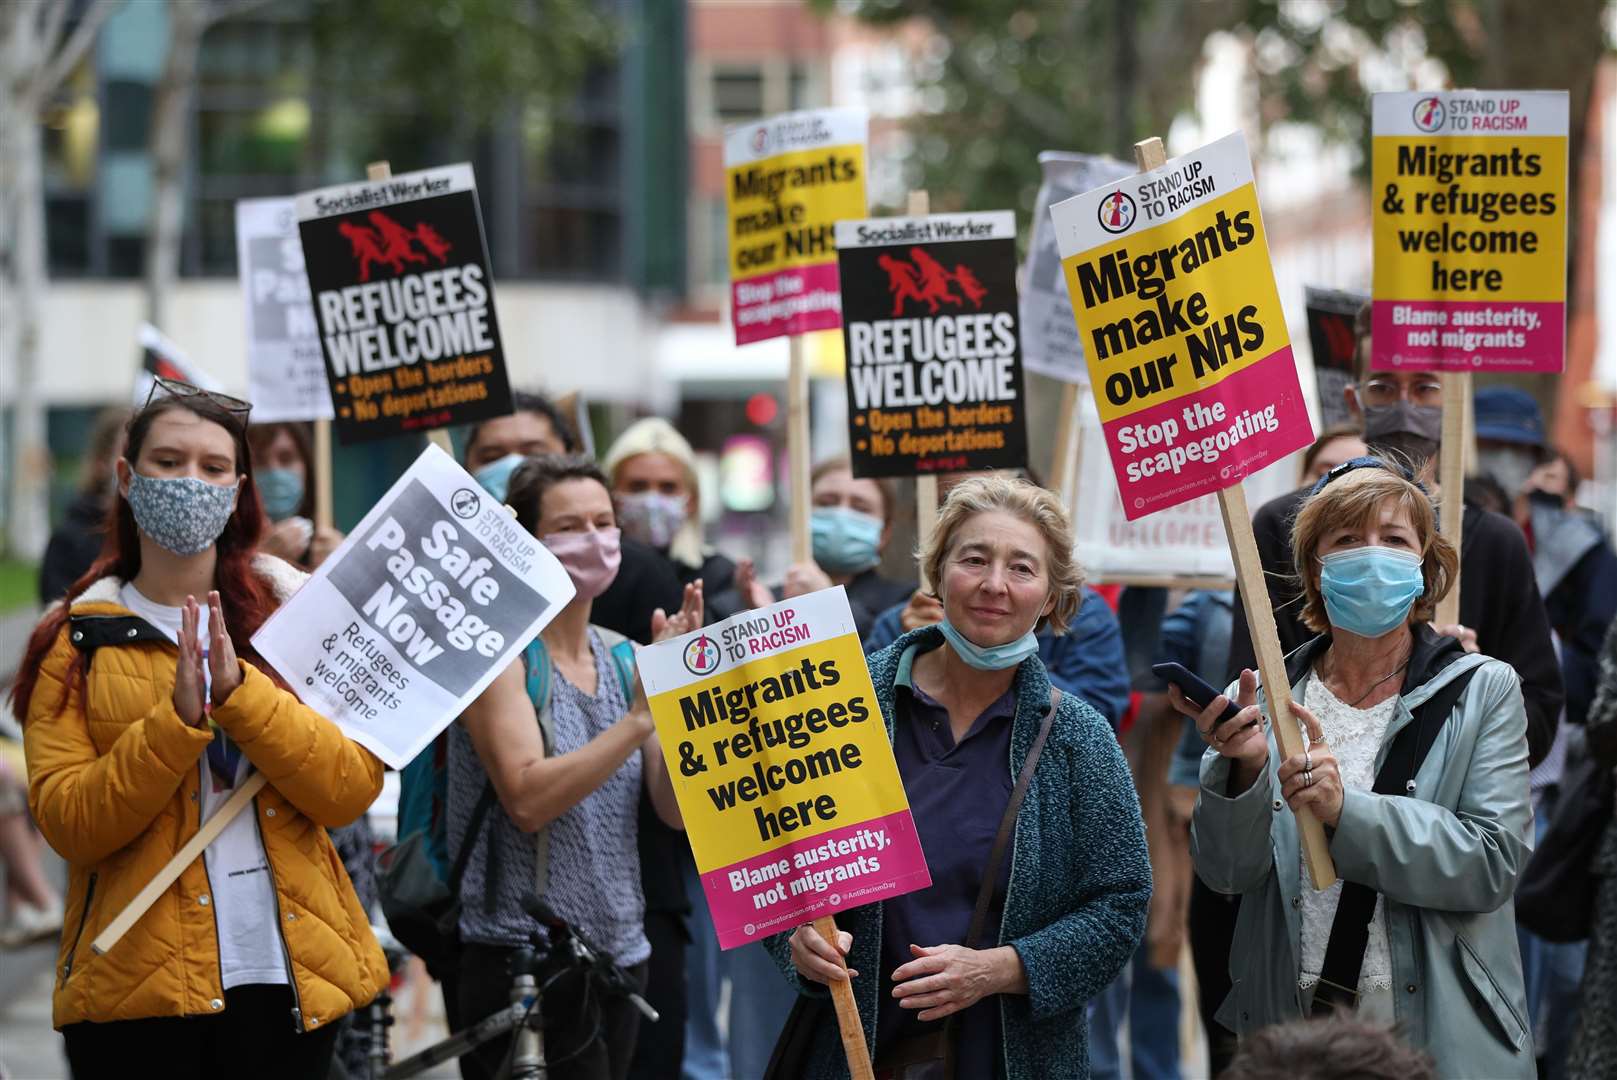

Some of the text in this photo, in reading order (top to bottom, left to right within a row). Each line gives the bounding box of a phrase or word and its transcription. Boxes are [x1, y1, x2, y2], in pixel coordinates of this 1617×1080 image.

[1450, 100, 1520, 114] STAND UP
[1450, 116, 1527, 130] TO RACISM
[734, 155, 856, 202] Migrants
[1138, 161, 1202, 202] STAND UP
[1397, 145, 1541, 184] Migrants
[315, 177, 451, 215] Socialist Worker
[735, 203, 806, 237] make
[1142, 175, 1216, 220] TO RACISM
[1382, 183, 1556, 222] & refugees
[736, 225, 835, 270] our NH
[857, 220, 993, 244] Socialist Worker
[1399, 223, 1538, 253] welcome
[1076, 209, 1255, 310] Migrants
[1432, 261, 1503, 291] here
[318, 263, 487, 335] REFUGEES
[736, 275, 804, 306] Stop the
[850, 312, 1015, 366] REFUGEES
[1091, 291, 1209, 360] make
[1393, 306, 1541, 330] Blame austerity,
[1407, 329, 1526, 351] not migrants
[325, 308, 494, 377] WELCOME
[1105, 305, 1265, 406] our NHS
[350, 355, 493, 400] Open the borders
[353, 399, 378, 422] No
[382, 381, 487, 417] deportations
[851, 357, 1016, 409] WELCOME
[868, 403, 1013, 434] Open the borders
[1117, 399, 1226, 454] Stop the
[870, 428, 1005, 458] No deportations
[1126, 404, 1280, 483] scapegoating
[475, 520, 532, 575] TO RACISM
[483, 509, 536, 567] STAND UP
[421, 520, 499, 605] Safe
[366, 516, 505, 658] Passage
[362, 581, 445, 666] Now
[721, 609, 795, 645] STAND UP
[726, 623, 810, 662] TO RACISM
[322, 633, 402, 710] & migrants
[342, 621, 410, 690] Refugees
[314, 659, 378, 719] welcome
[678, 658, 841, 732] Migrants
[678, 696, 869, 777] & refugees
[707, 743, 863, 811] welcome
[753, 794, 837, 842] here
[728, 828, 892, 892] Blame austerity,
[752, 855, 881, 910] not migrants
